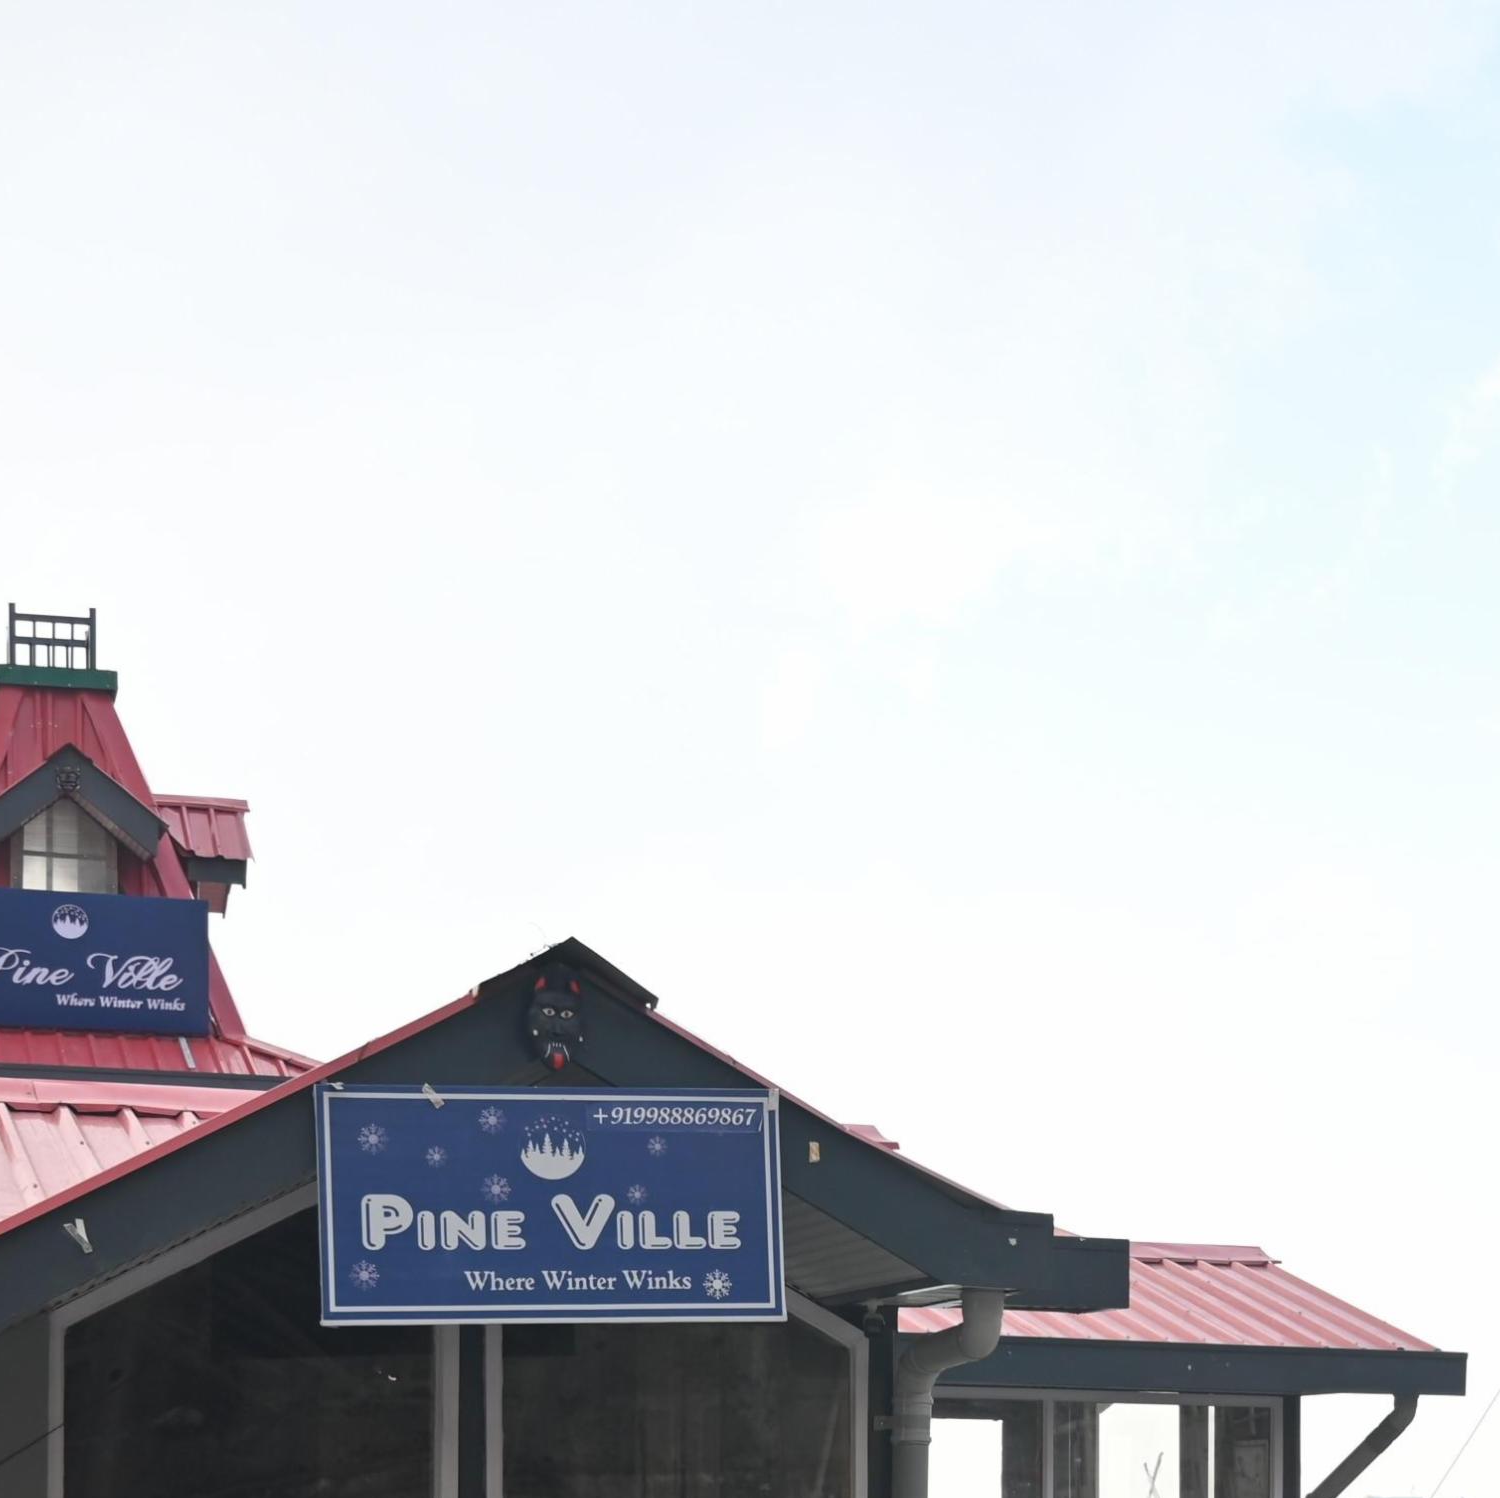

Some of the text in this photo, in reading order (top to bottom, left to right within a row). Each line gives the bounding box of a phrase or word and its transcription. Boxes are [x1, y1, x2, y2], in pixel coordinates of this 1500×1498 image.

[87, 953, 183, 991] Ville
[55, 992, 186, 1011] Where Winter Winks
[593, 1106, 757, 1127] +919988869867
[360, 1193, 742, 1251] PINE VILLE
[463, 1269, 692, 1292] Where Winter Winks
